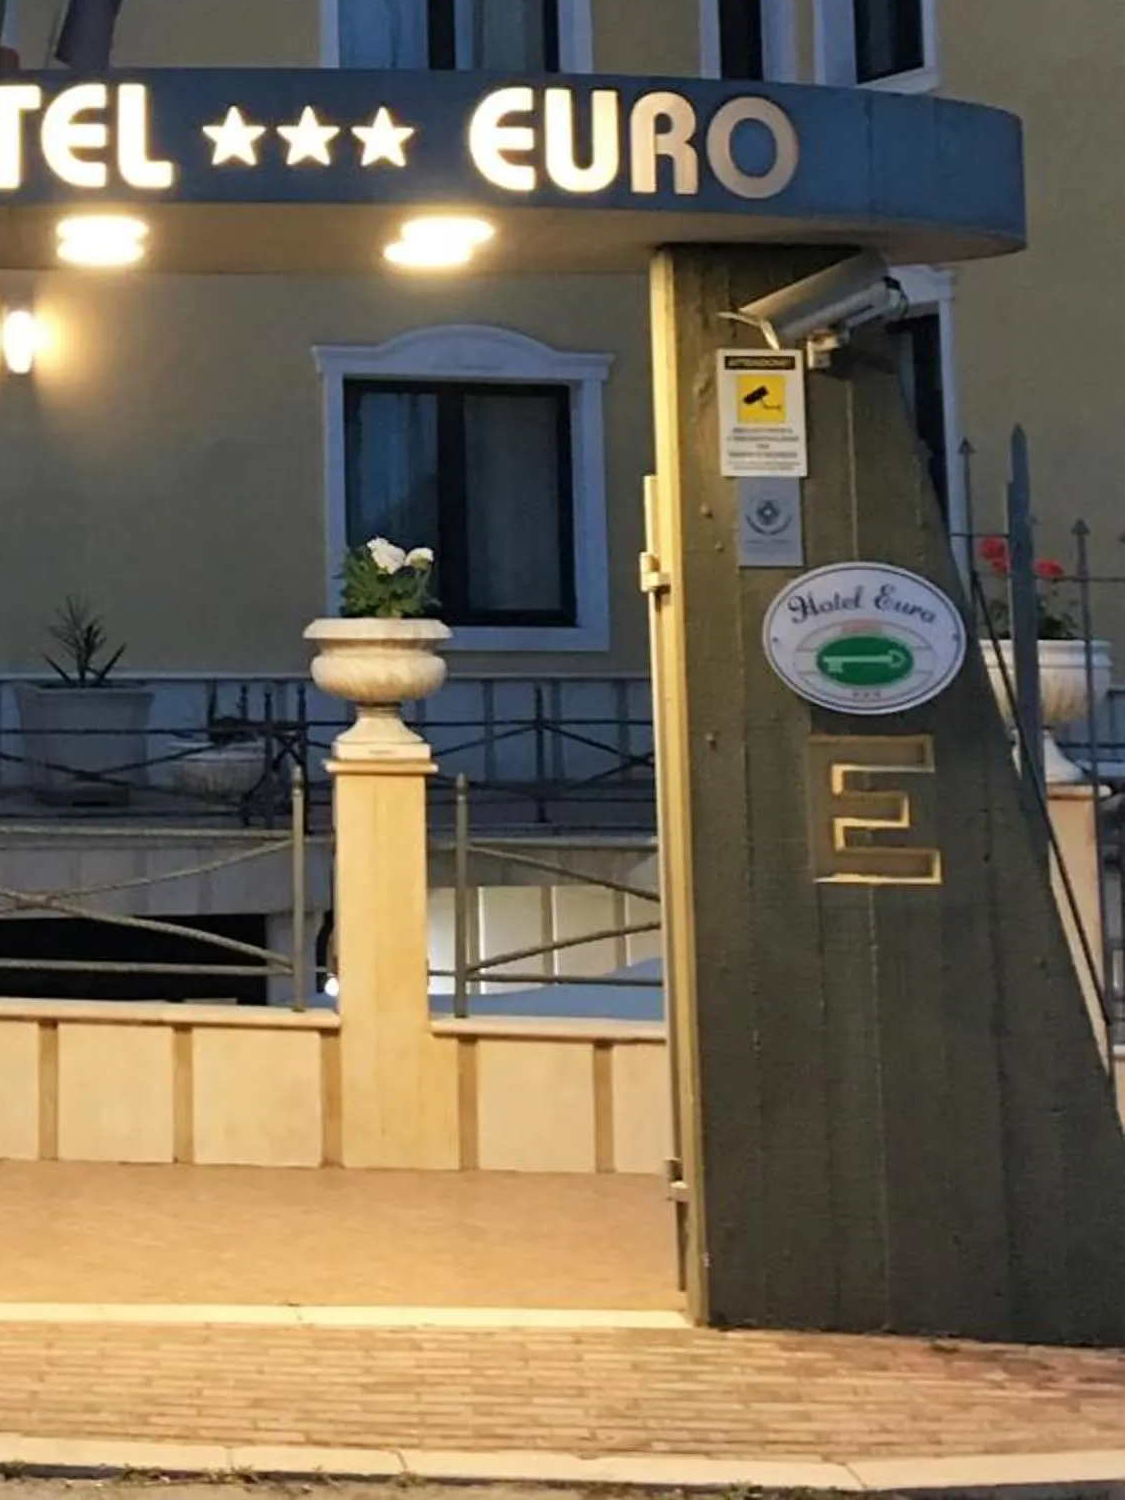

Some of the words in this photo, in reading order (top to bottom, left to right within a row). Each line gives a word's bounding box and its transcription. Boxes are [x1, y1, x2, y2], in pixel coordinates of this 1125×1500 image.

[468, 86, 799, 199] EURO
[787, 585, 864, 623] Hotel
[873, 583, 937, 623] Euro
